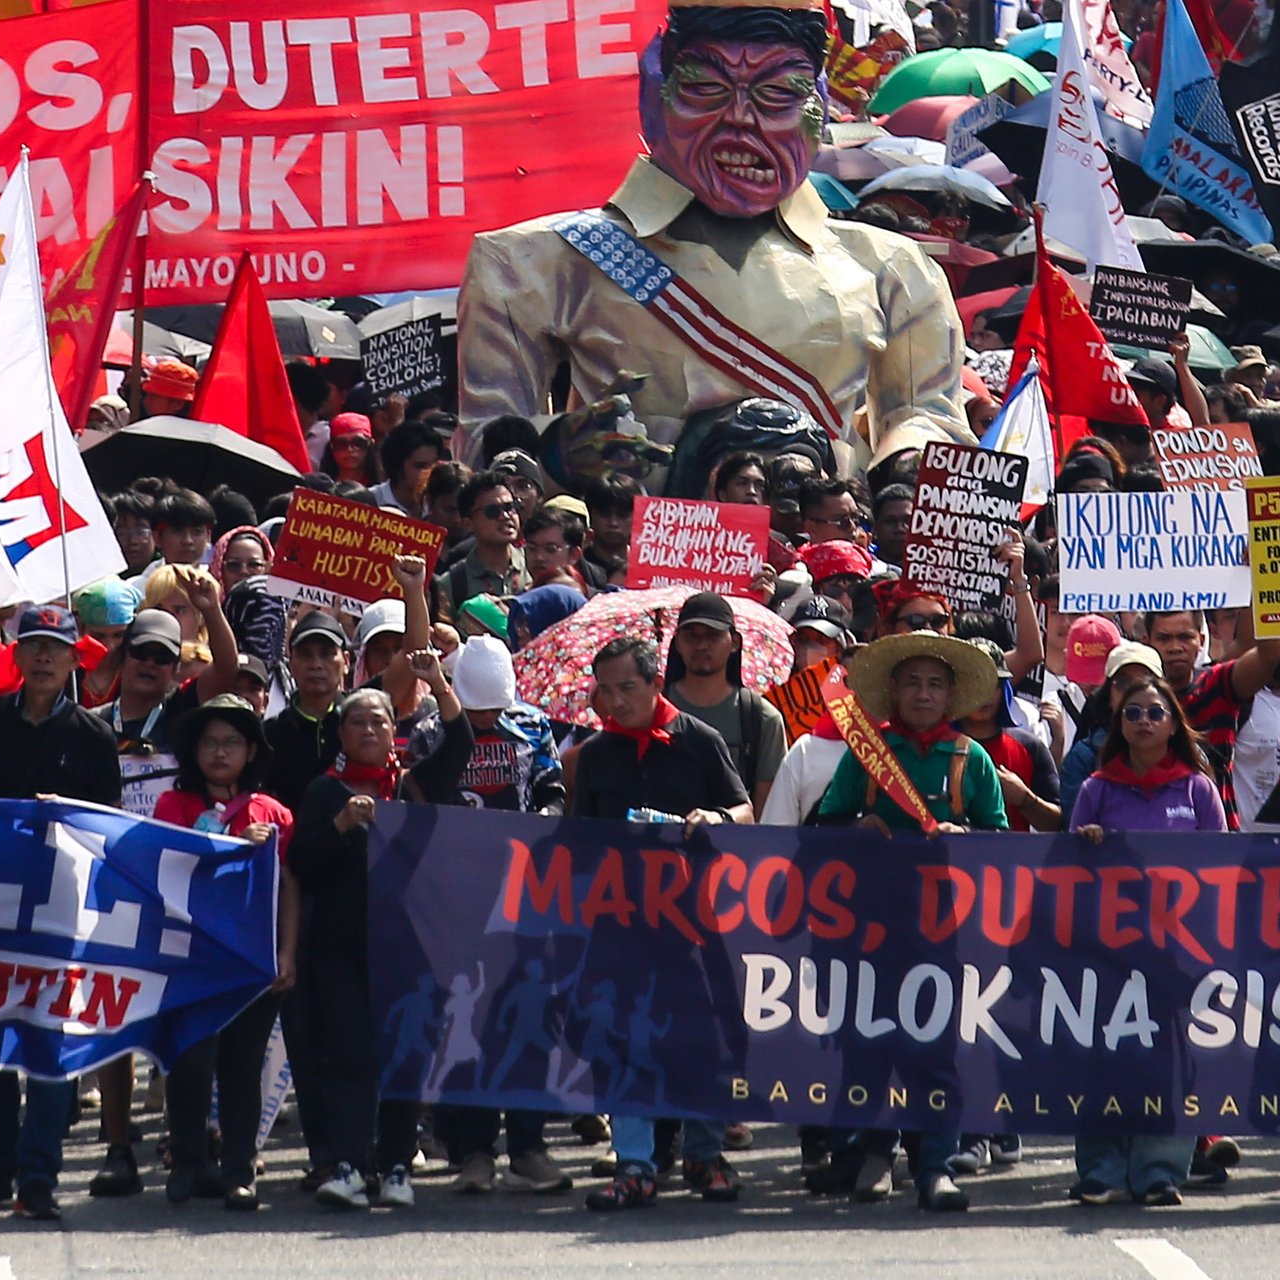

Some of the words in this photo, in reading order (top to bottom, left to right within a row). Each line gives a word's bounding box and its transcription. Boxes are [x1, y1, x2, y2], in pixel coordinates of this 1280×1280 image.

[145, 256, 230, 288] MAYO
[253, 251, 327, 285] UNO
[1096, 271, 1172, 297] PAMBANSANG
[1091, 302, 1181, 331] IPAGLABAN
[362, 332, 435, 369] TRANSITION
[369, 319, 434, 351] NATIONAL
[370, 358, 441, 394] ISULONG!
[1152, 429, 1228, 458] PONDO
[1232, 436, 1254, 453] SA
[925, 444, 1022, 488] ISULONG
[1160, 454, 1264, 482] EDUKASYON
[946, 476, 988, 494] ang
[918, 484, 1022, 521] PAMBANSANG
[1064, 493, 1178, 538] IKULONG
[1191, 492, 1235, 536] NA
[289, 519, 364, 549] LUMABAN
[637, 522, 715, 553] BAGUHIN
[715, 528, 756, 558] ANG
[638, 543, 689, 568] BULOK
[691, 551, 713, 574] NA
[906, 543, 1009, 577] SOSYALISTANG
[1061, 535, 1105, 570] YAN
[1117, 533, 1164, 571] MGA
[1171, 533, 1250, 569] KURAKO
[1259, 563, 1267, 575] &
[907, 562, 1001, 596] PERSPEKTIBA
[1267, 614, 1280, 622] ALL
[502, 837, 887, 953] MARCOS,
[740, 953, 1023, 1061] BULOK
[1039, 965, 1160, 1052] NA
[730, 1076, 948, 1111] BAGONG
